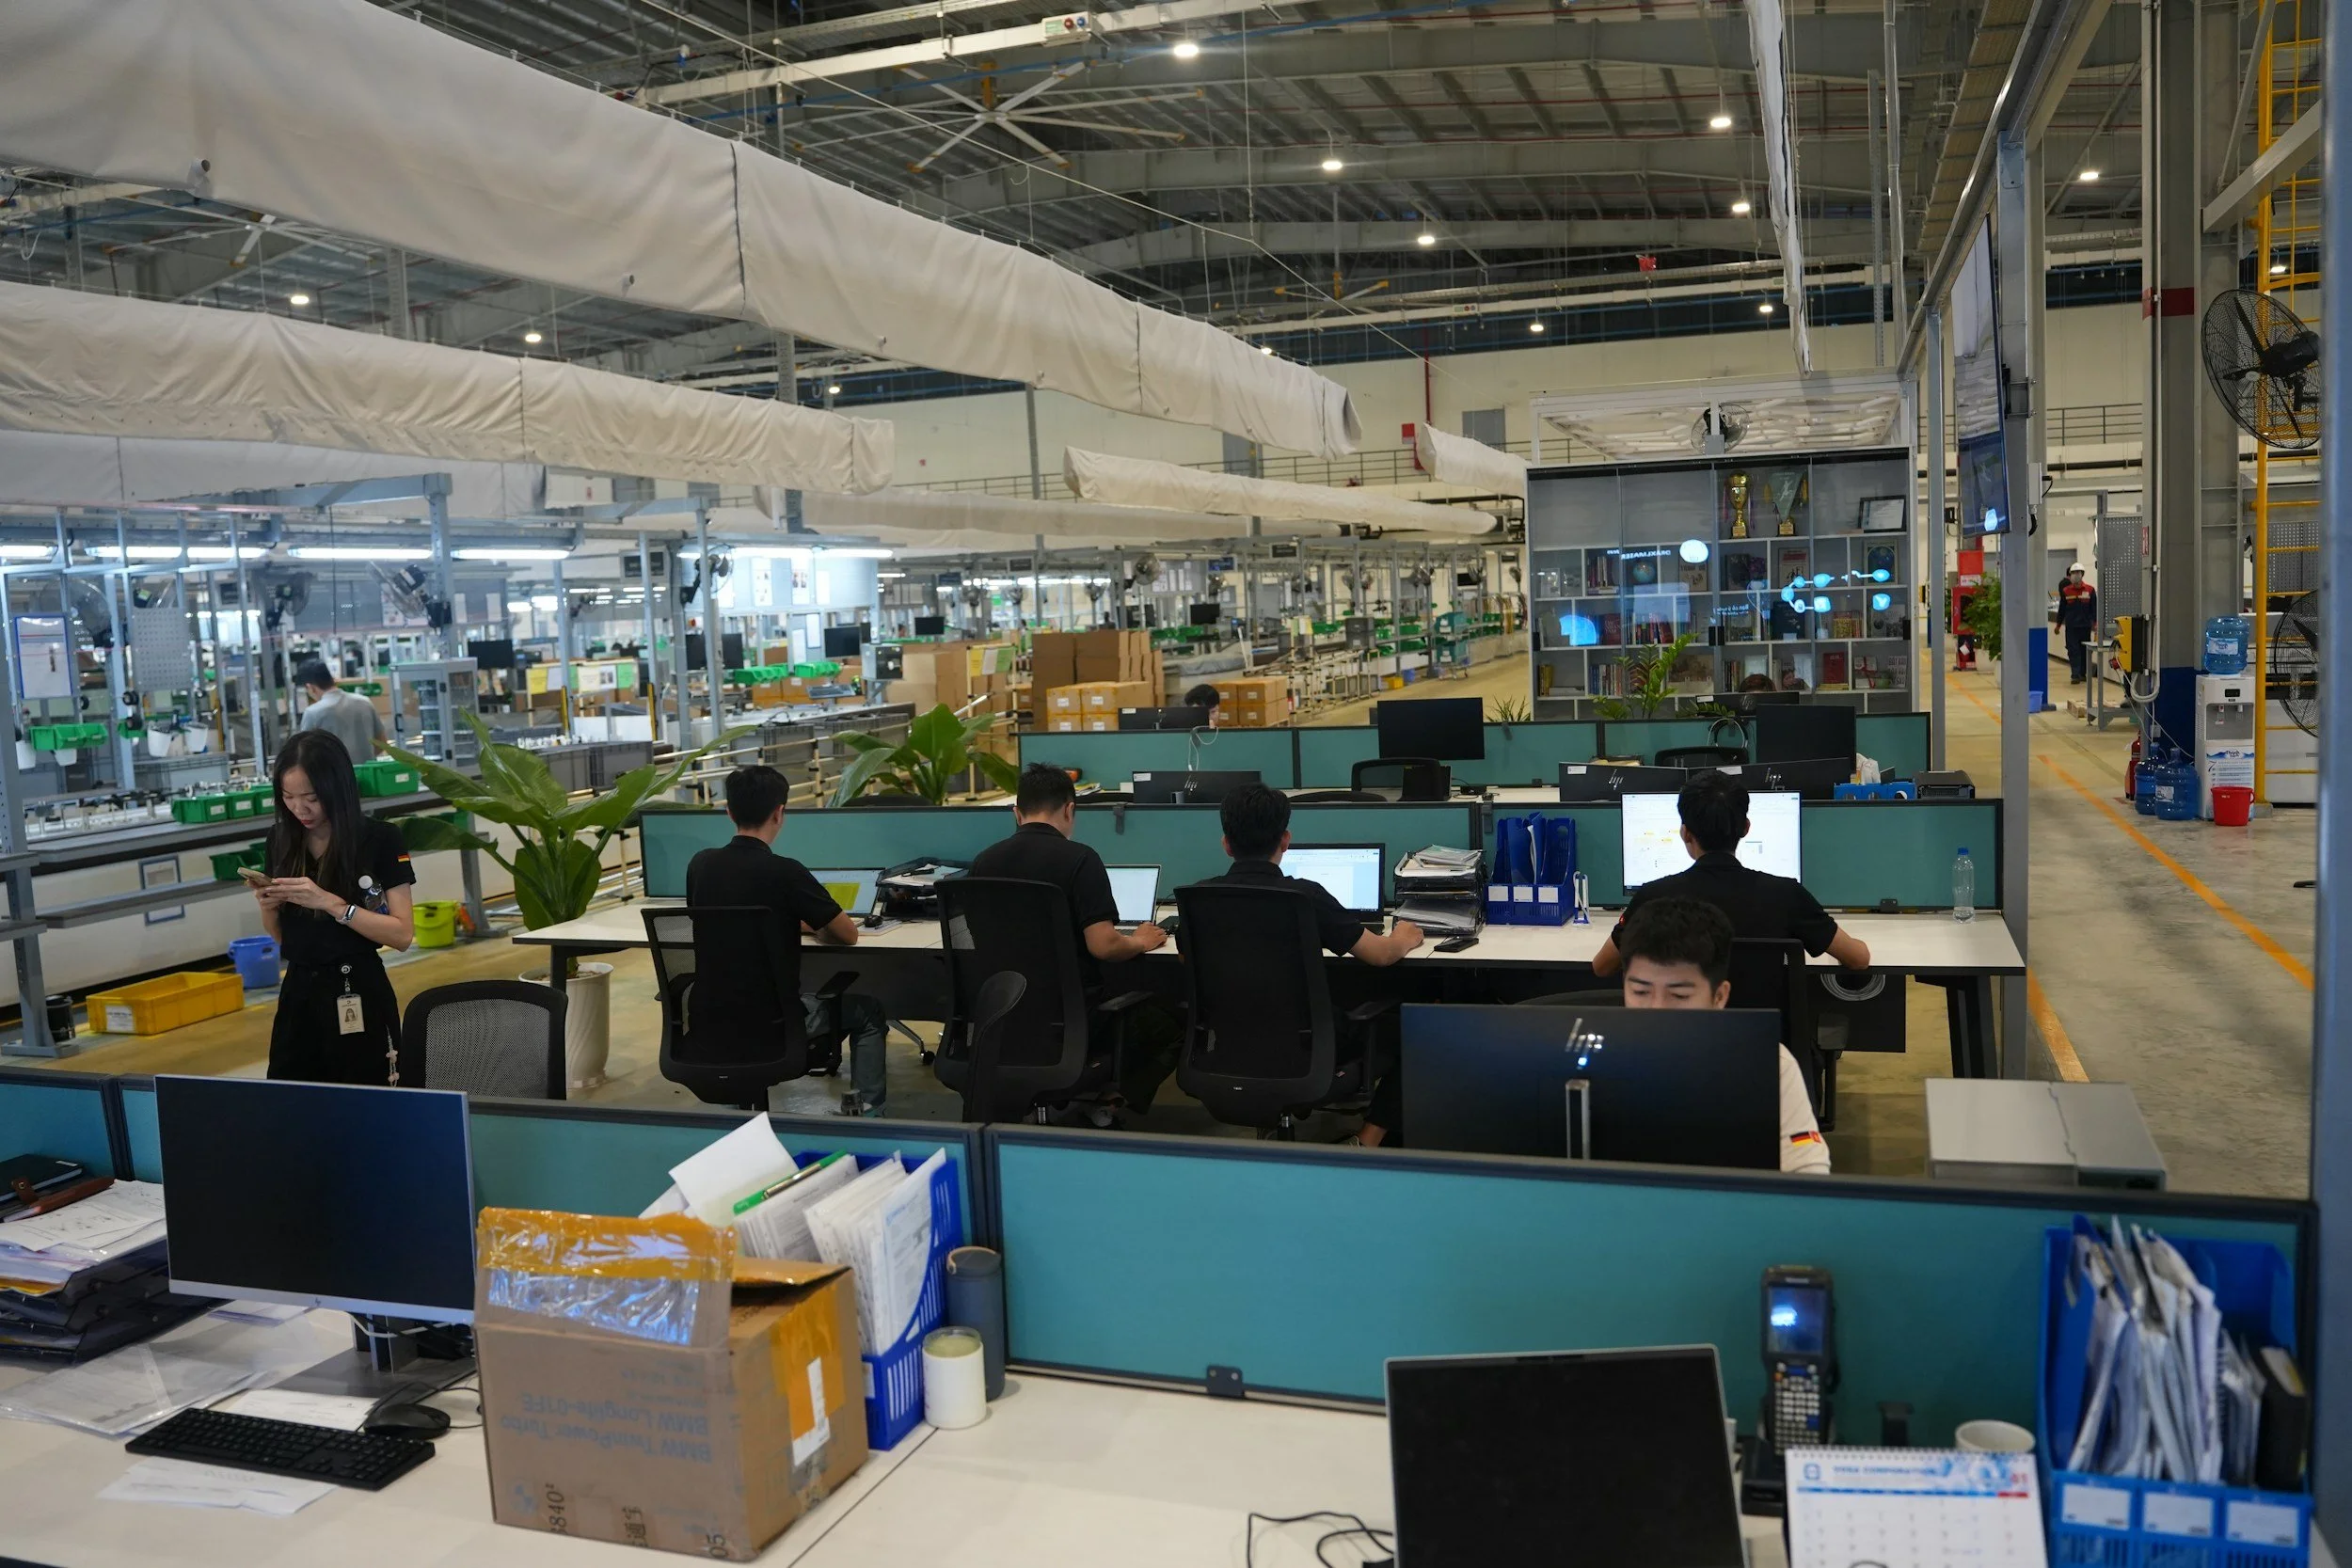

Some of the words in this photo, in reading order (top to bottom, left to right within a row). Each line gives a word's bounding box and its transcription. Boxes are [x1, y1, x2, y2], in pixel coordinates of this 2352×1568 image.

[1184, 774, 1200, 796] hp
[1608, 768, 1624, 791] hp
[1764, 767, 1782, 790] hp
[1565, 1017, 1605, 1070] hp
[657, 1411, 709, 1436] BMW
[660, 1438, 712, 1464] BMW
